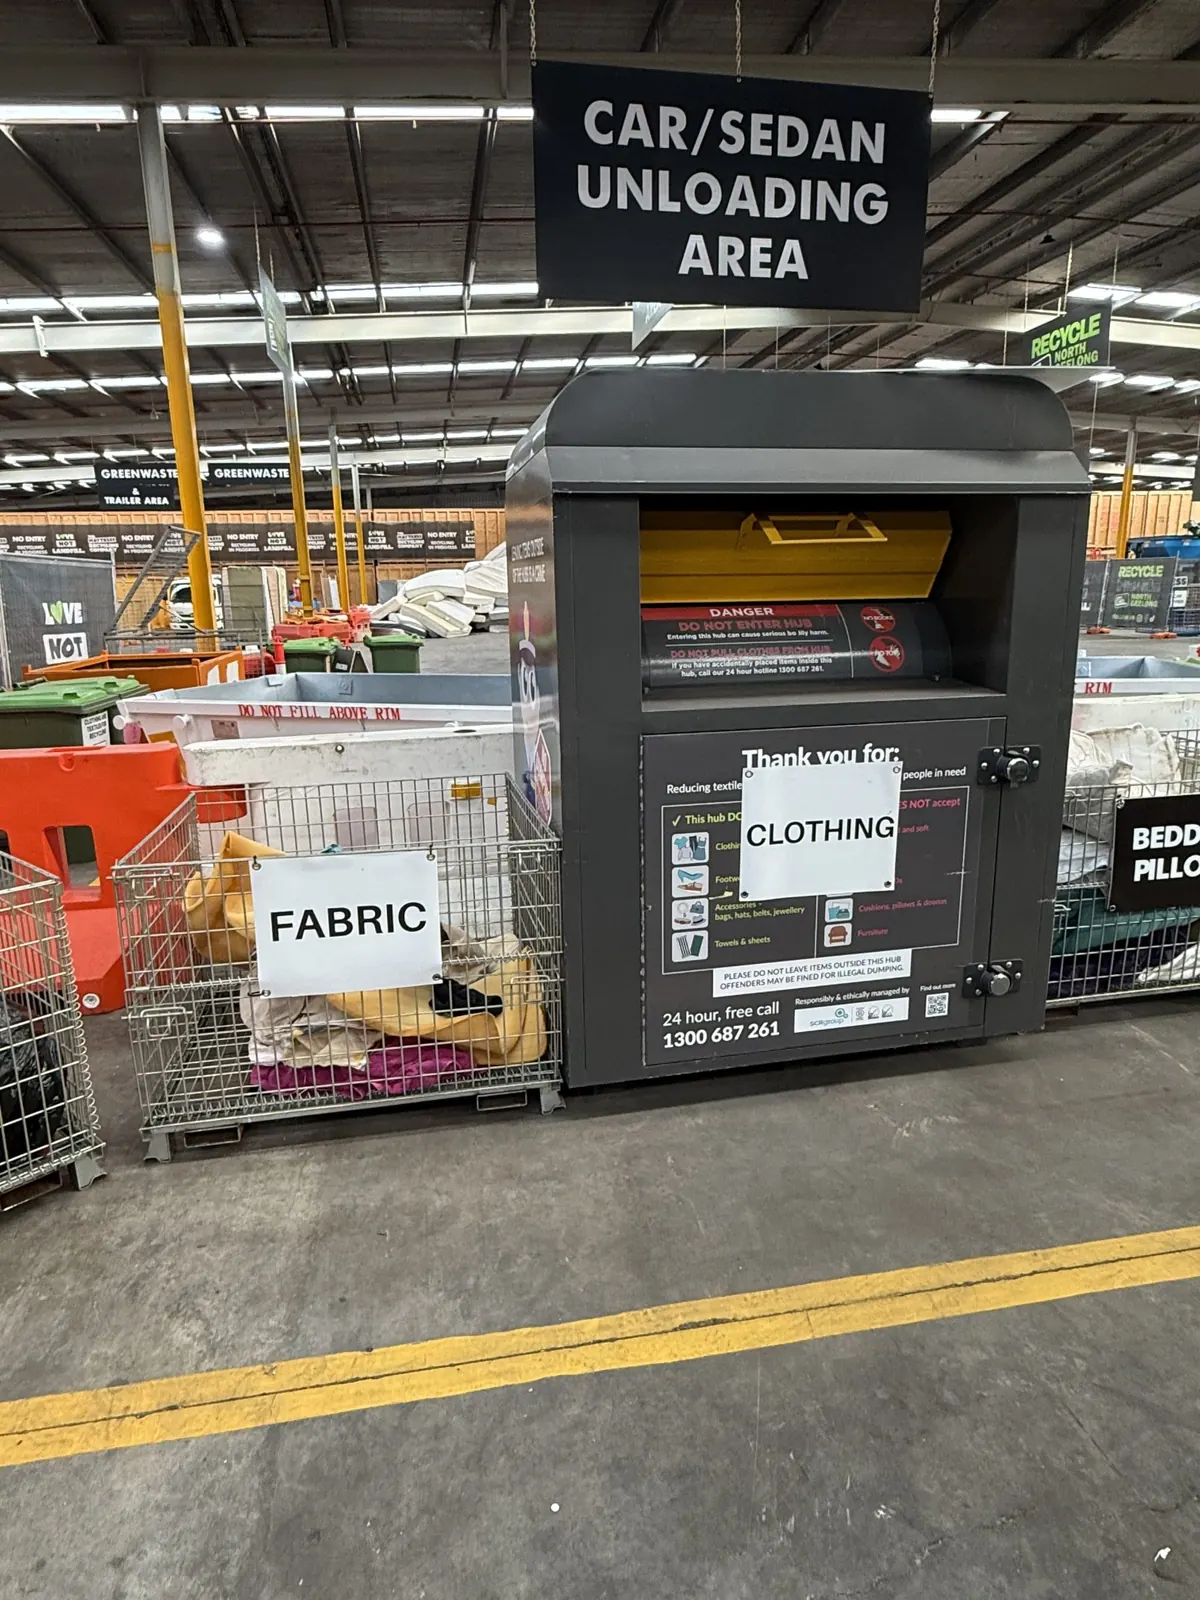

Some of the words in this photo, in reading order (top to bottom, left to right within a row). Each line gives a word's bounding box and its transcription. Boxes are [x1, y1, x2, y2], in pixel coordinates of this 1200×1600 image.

[584, 100, 885, 164] CAR/SEDAN
[577, 164, 889, 225] UNLOADING
[678, 234, 809, 280] AREA
[1031, 312, 1102, 359] RECYCLE
[1055, 341, 1087, 363] NORTH
[101, 468, 179, 479] GREENWASTE
[214, 468, 290, 479] GREENWASTE
[132, 487, 140, 496] &
[104, 496, 142, 505] TRAILER
[144, 496, 169, 505] AREA
[1118, 565, 1164, 578] RECYCLE
[709, 607, 774, 617] DANGER
[679, 622, 699, 631] DO
[703, 621, 732, 630] NOT
[736, 620, 782, 630] ENTER
[784, 619, 813, 628] HUB
[667, 633, 697, 641] Entering
[48, 637, 83, 659] NOT
[671, 650, 685, 658] DO
[688, 650, 708, 658] NOT
[755, 659, 778, 667] placed
[698, 669, 711, 677] call
[1084, 681, 1113, 694] RIM
[238, 704, 255, 717] DO
[260, 704, 283, 718] NOT
[290, 706, 321, 719] FILL
[329, 706, 368, 719] ABOVE
[376, 707, 401, 720] RIM
[742, 746, 812, 768] Thank
[816, 750, 857, 764] you
[863, 743, 900, 762] for:
[667, 782, 711, 794] Reducing
[903, 769, 932, 781] people
[934, 768, 943, 777] in
[944, 766, 966, 776] need
[909, 799, 932, 809] NOT
[932, 798, 961, 809] accept
[685, 814, 706, 824] This
[707, 813, 725, 823] hub
[746, 816, 895, 847] CLOTHING
[902, 825, 915, 833] and
[1133, 824, 1200, 850] BEDD
[1134, 855, 1200, 882] PILLO
[715, 902, 756, 911] Accessories
[715, 913, 733, 921] bags,
[753, 909, 772, 917] belts,
[773, 906, 805, 917] jewellery
[270, 901, 427, 942] FABRIC
[715, 939, 739, 948] Towels
[741, 938, 747, 946] &
[748, 936, 771, 945] sheets
[724, 971, 752, 981] PLEASE
[753, 970, 765, 978] DO
[767, 968, 784, 976] NOT
[785, 965, 808, 974] LEAVE
[810, 963, 832, 972] ITEMS
[834, 959, 866, 969] OUTSIDE
[868, 957, 884, 966] THIS
[885, 956, 901, 964] HUB
[720, 979, 766, 990] OFFENDERS
[767, 977, 784, 985] MAY
[785, 975, 795, 983] BE
[797, 973, 819, 982] FINED
[821, 971, 836, 979] FOR
[837, 968, 865, 977] ILLEGAL
[867, 964, 904, 975] DUMPING.
[795, 994, 834, 1006] Responsibly
[843, 990, 870, 1000] ethically
[871, 988, 900, 997] managed
[901, 987, 910, 995] by
[663, 1012, 682, 1026] 24
[686, 1011, 721, 1024] hour,
[725, 1006, 753, 1019] free
[756, 1001, 780, 1016] call
[663, 1029, 707, 1048] 1300
[711, 1024, 744, 1042] 687
[748, 1021, 780, 1038] 261
